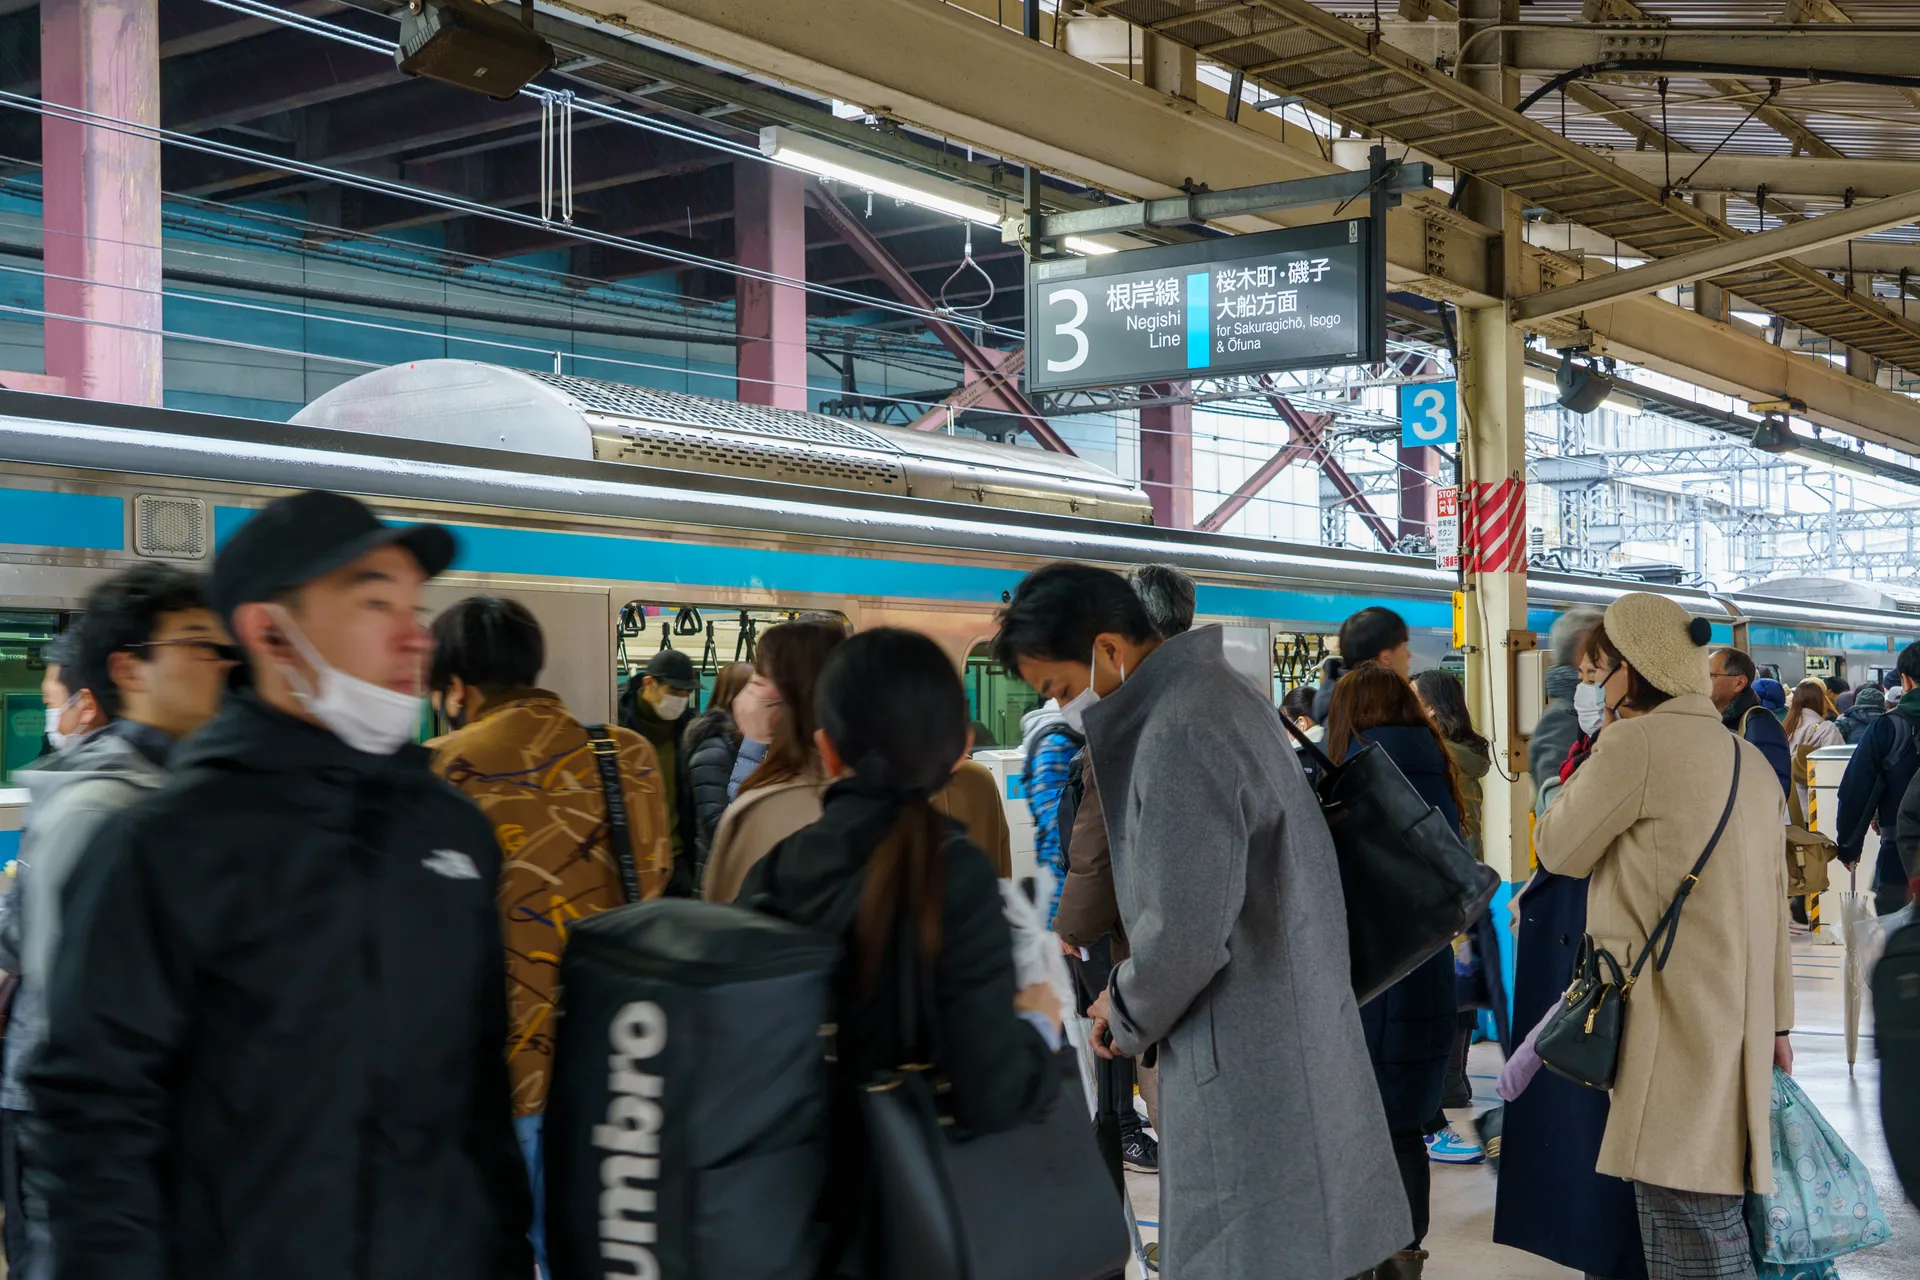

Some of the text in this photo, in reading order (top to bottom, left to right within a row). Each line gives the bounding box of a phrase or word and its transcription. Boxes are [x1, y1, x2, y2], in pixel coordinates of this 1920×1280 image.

[1216, 258, 1331, 294] 桜木町・磯子
[1106, 277, 1181, 313] 根岸線
[1216, 289, 1298, 321] 大船方面
[1047, 288, 1090, 373] 3
[1126, 310, 1181, 333] Negishi
[1216, 325, 1232, 337] for
[1309, 314, 1341, 329] Isogo
[1149, 332, 1181, 349] Line
[1216, 336, 1262, 354] & Ōfuna
[1412, 389, 1448, 441] 3
[1512, 469, 1520, 487] 19
[1438, 490, 1456, 499] STOP
